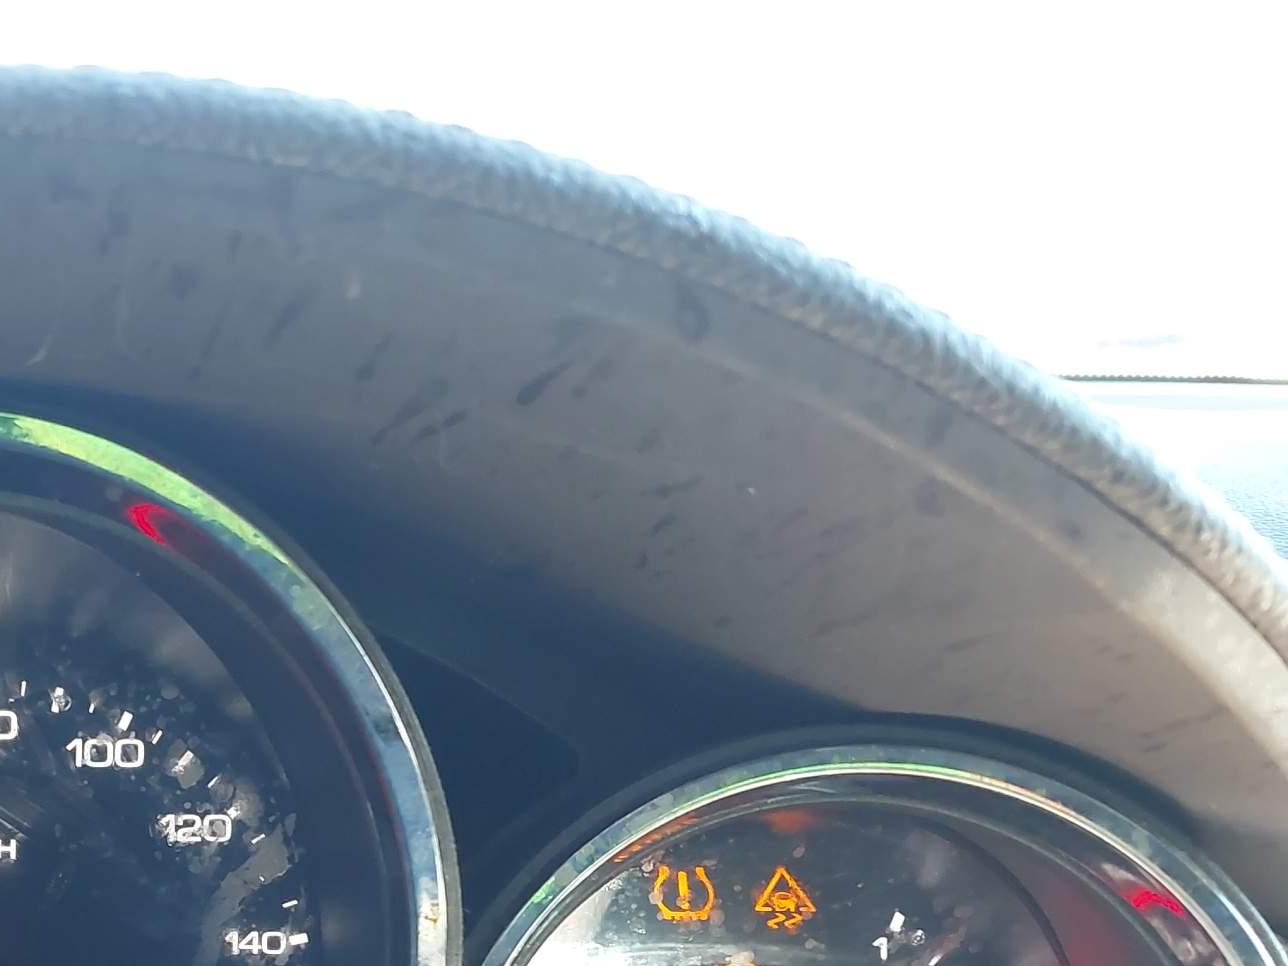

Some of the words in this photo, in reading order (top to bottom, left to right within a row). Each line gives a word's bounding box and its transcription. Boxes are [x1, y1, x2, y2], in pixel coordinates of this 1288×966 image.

[66, 738, 145, 768] 100
[160, 813, 232, 843] 120
[224, 930, 287, 956] 140
